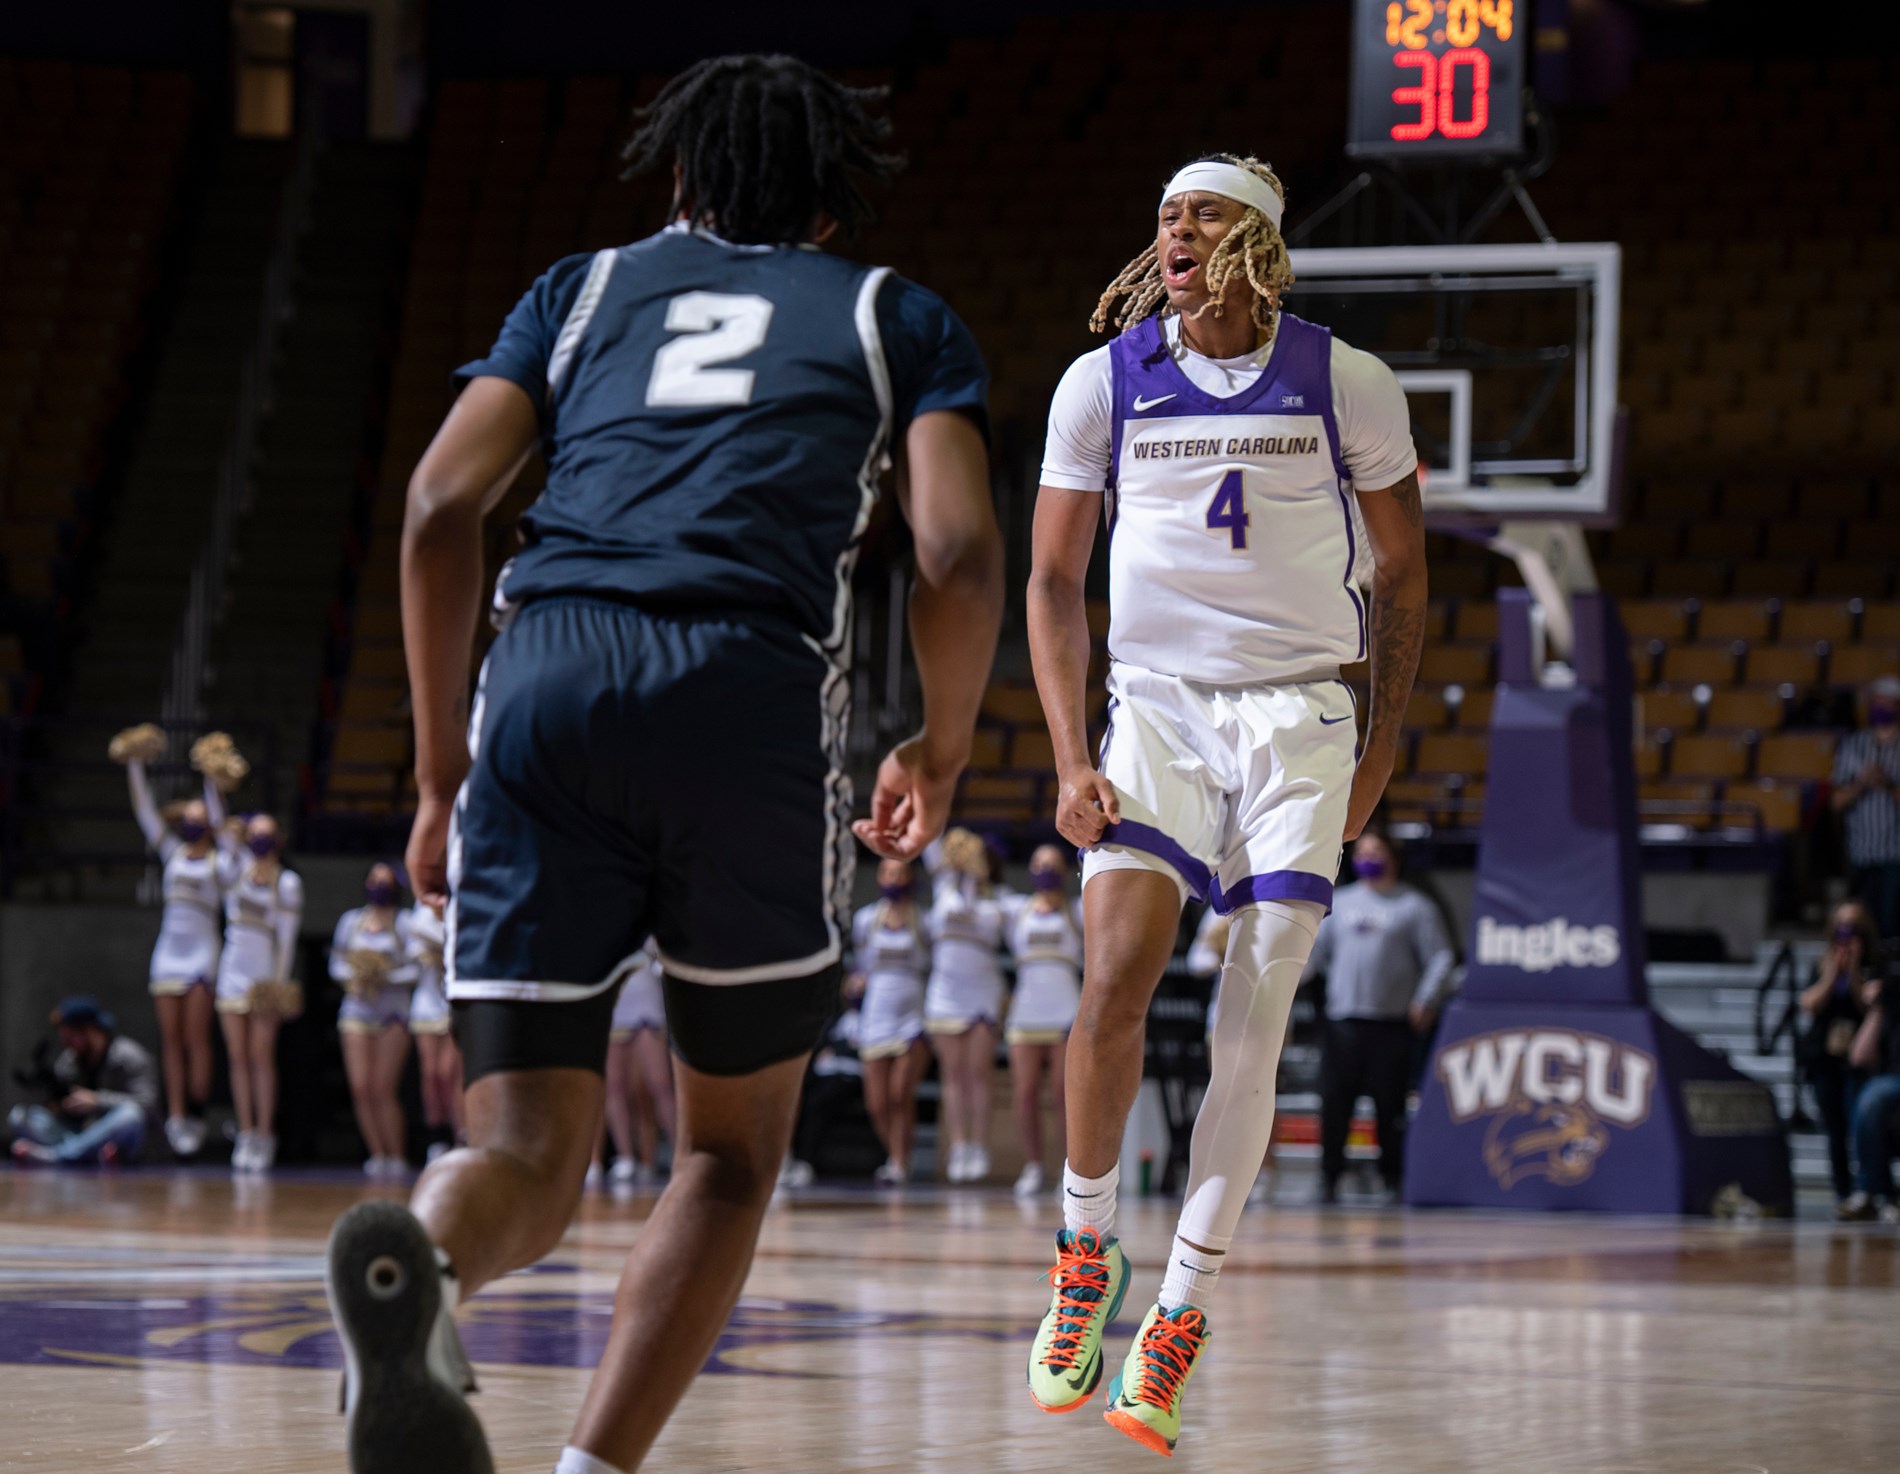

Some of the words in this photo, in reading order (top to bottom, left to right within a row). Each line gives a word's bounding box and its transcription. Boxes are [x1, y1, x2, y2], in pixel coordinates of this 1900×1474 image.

[1386, 0, 1513, 50] 12:04
[1390, 47, 1490, 141] 30
[645, 290, 775, 407] 2
[1134, 438, 1222, 459] WESTERN
[1226, 436, 1319, 456] CAROLINA
[1206, 468, 1250, 551] 4
[1476, 915, 1620, 972] ingles
[1438, 1028, 1656, 1126] WCU
